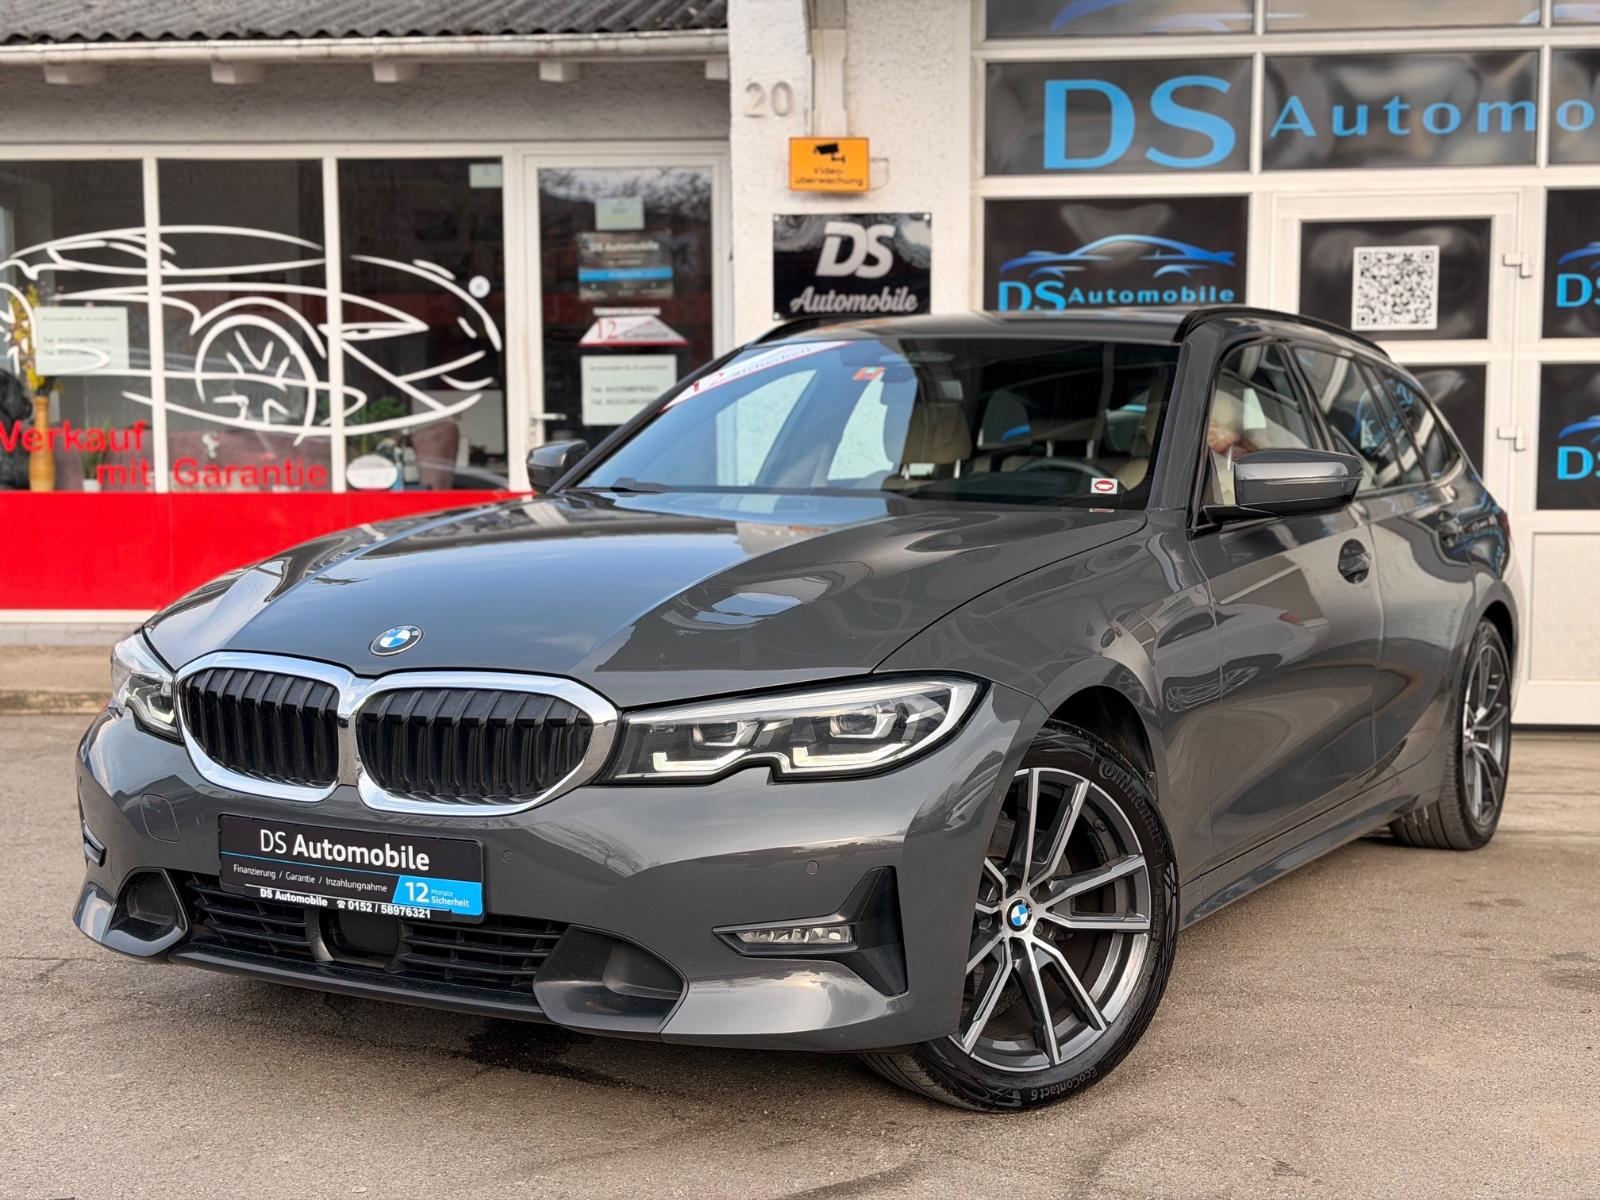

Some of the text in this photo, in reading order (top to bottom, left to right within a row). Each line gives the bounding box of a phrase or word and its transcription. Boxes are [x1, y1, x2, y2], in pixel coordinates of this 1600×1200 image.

[745, 81, 794, 118] 20
[1043, 75, 1237, 170] DS
[815, 221, 897, 279] DS
[789, 286, 919, 313] Automobile
[998, 280, 1235, 312] DS Automobile
[1556, 273, 1600, 308] D
[596, 320, 618, 340] 12
[0, 420, 147, 453] Verkauf
[96, 457, 329, 488] mit Garantie
[1557, 445, 1600, 480] D
[260, 829, 431, 871] DS Automobile
[233, 863, 276, 880] Finanzierung
[285, 871, 316, 884] Garantie
[325, 876, 388, 893] Inzahlungnahme
[404, 881, 431, 903] 12
[430, 888, 454, 897] Monate
[260, 887, 273, 899] DS
[275, 890, 328, 908] Automobile
[347, 899, 374, 913] 0152
[380, 903, 432, 920] 58976321
[431, 895, 470, 908] Sicherheit
